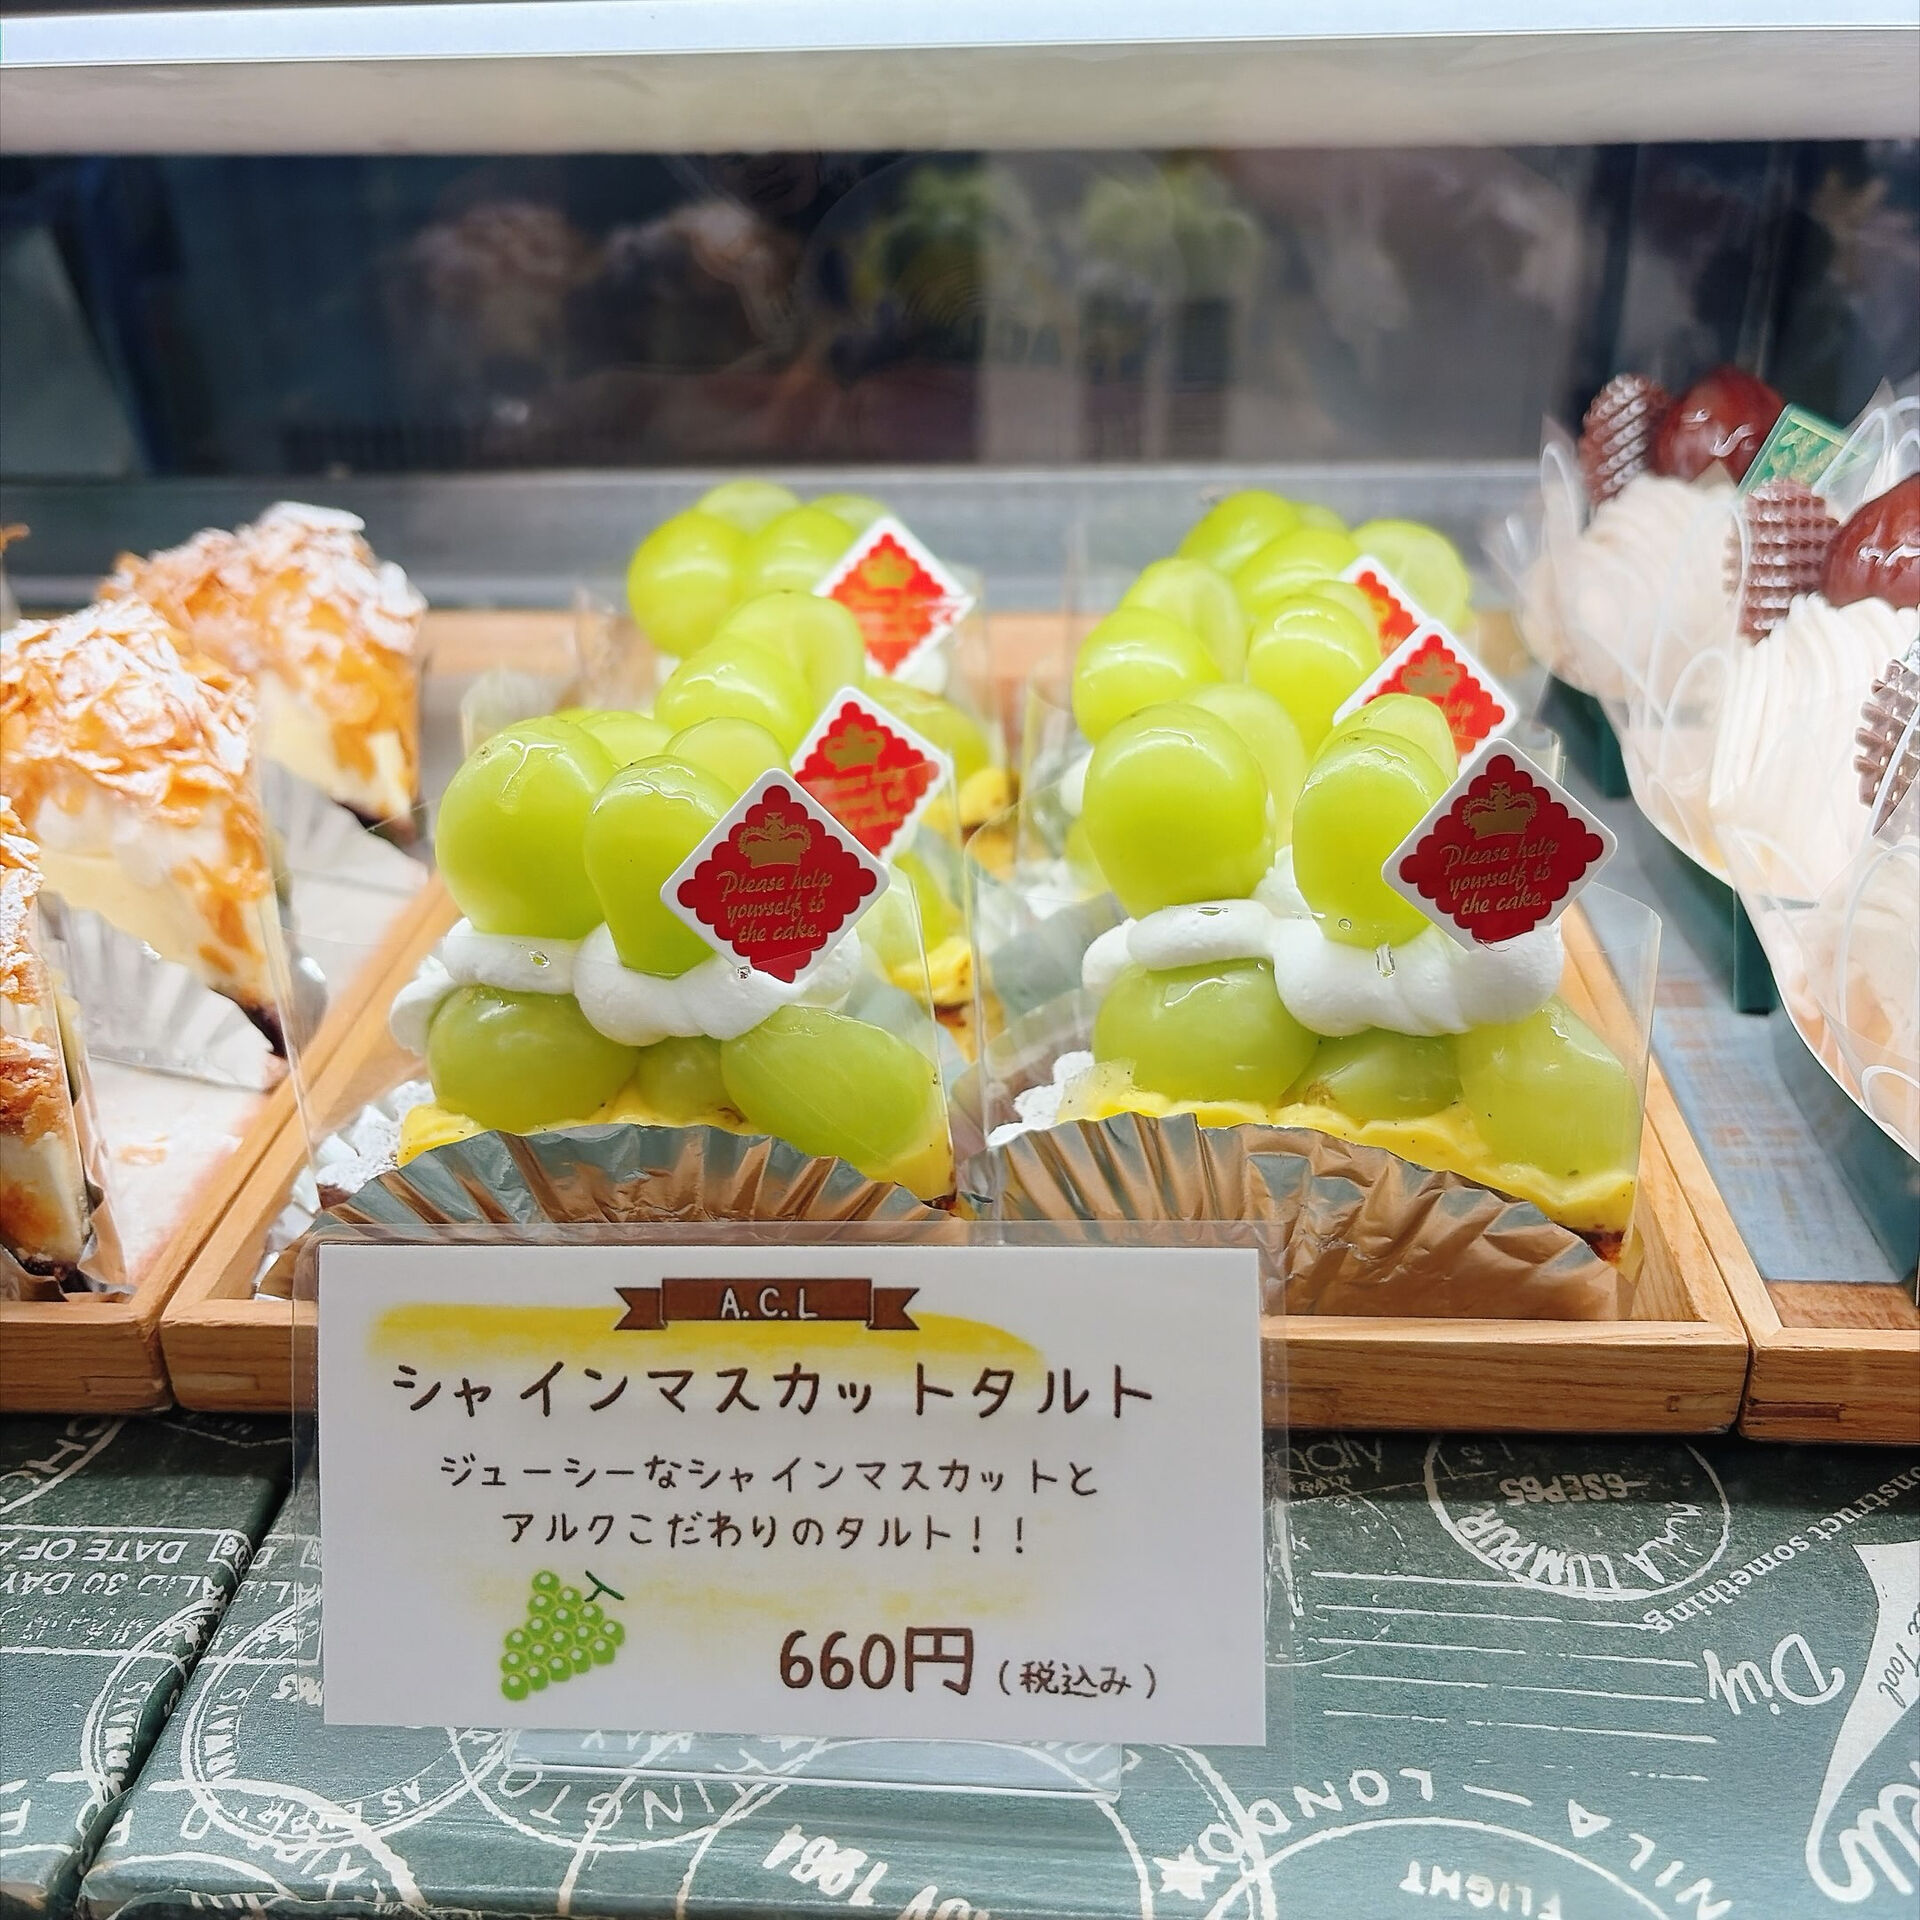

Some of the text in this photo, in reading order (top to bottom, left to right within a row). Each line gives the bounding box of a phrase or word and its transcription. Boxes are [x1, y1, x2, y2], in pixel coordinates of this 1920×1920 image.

[1440, 834, 1560, 875] Please help
[717, 866, 832, 902] Please help
[1450, 859, 1551, 900] yourself to
[727, 892, 825, 928] yourself to
[1461, 884, 1547, 915] the cake.
[739, 916, 821, 943] the cake.
[720, 1288, 818, 1320] A.C.L
[392, 1361, 1153, 1419] シャインマスカットタルト
[440, 1452, 1098, 1497] ジューシーなシャインマスカットと
[17, 1536, 76, 1559] OF
[80, 1538, 188, 1563] DATE
[1641, 1533, 1809, 1633] something
[779, 1626, 974, 1697] 660円
